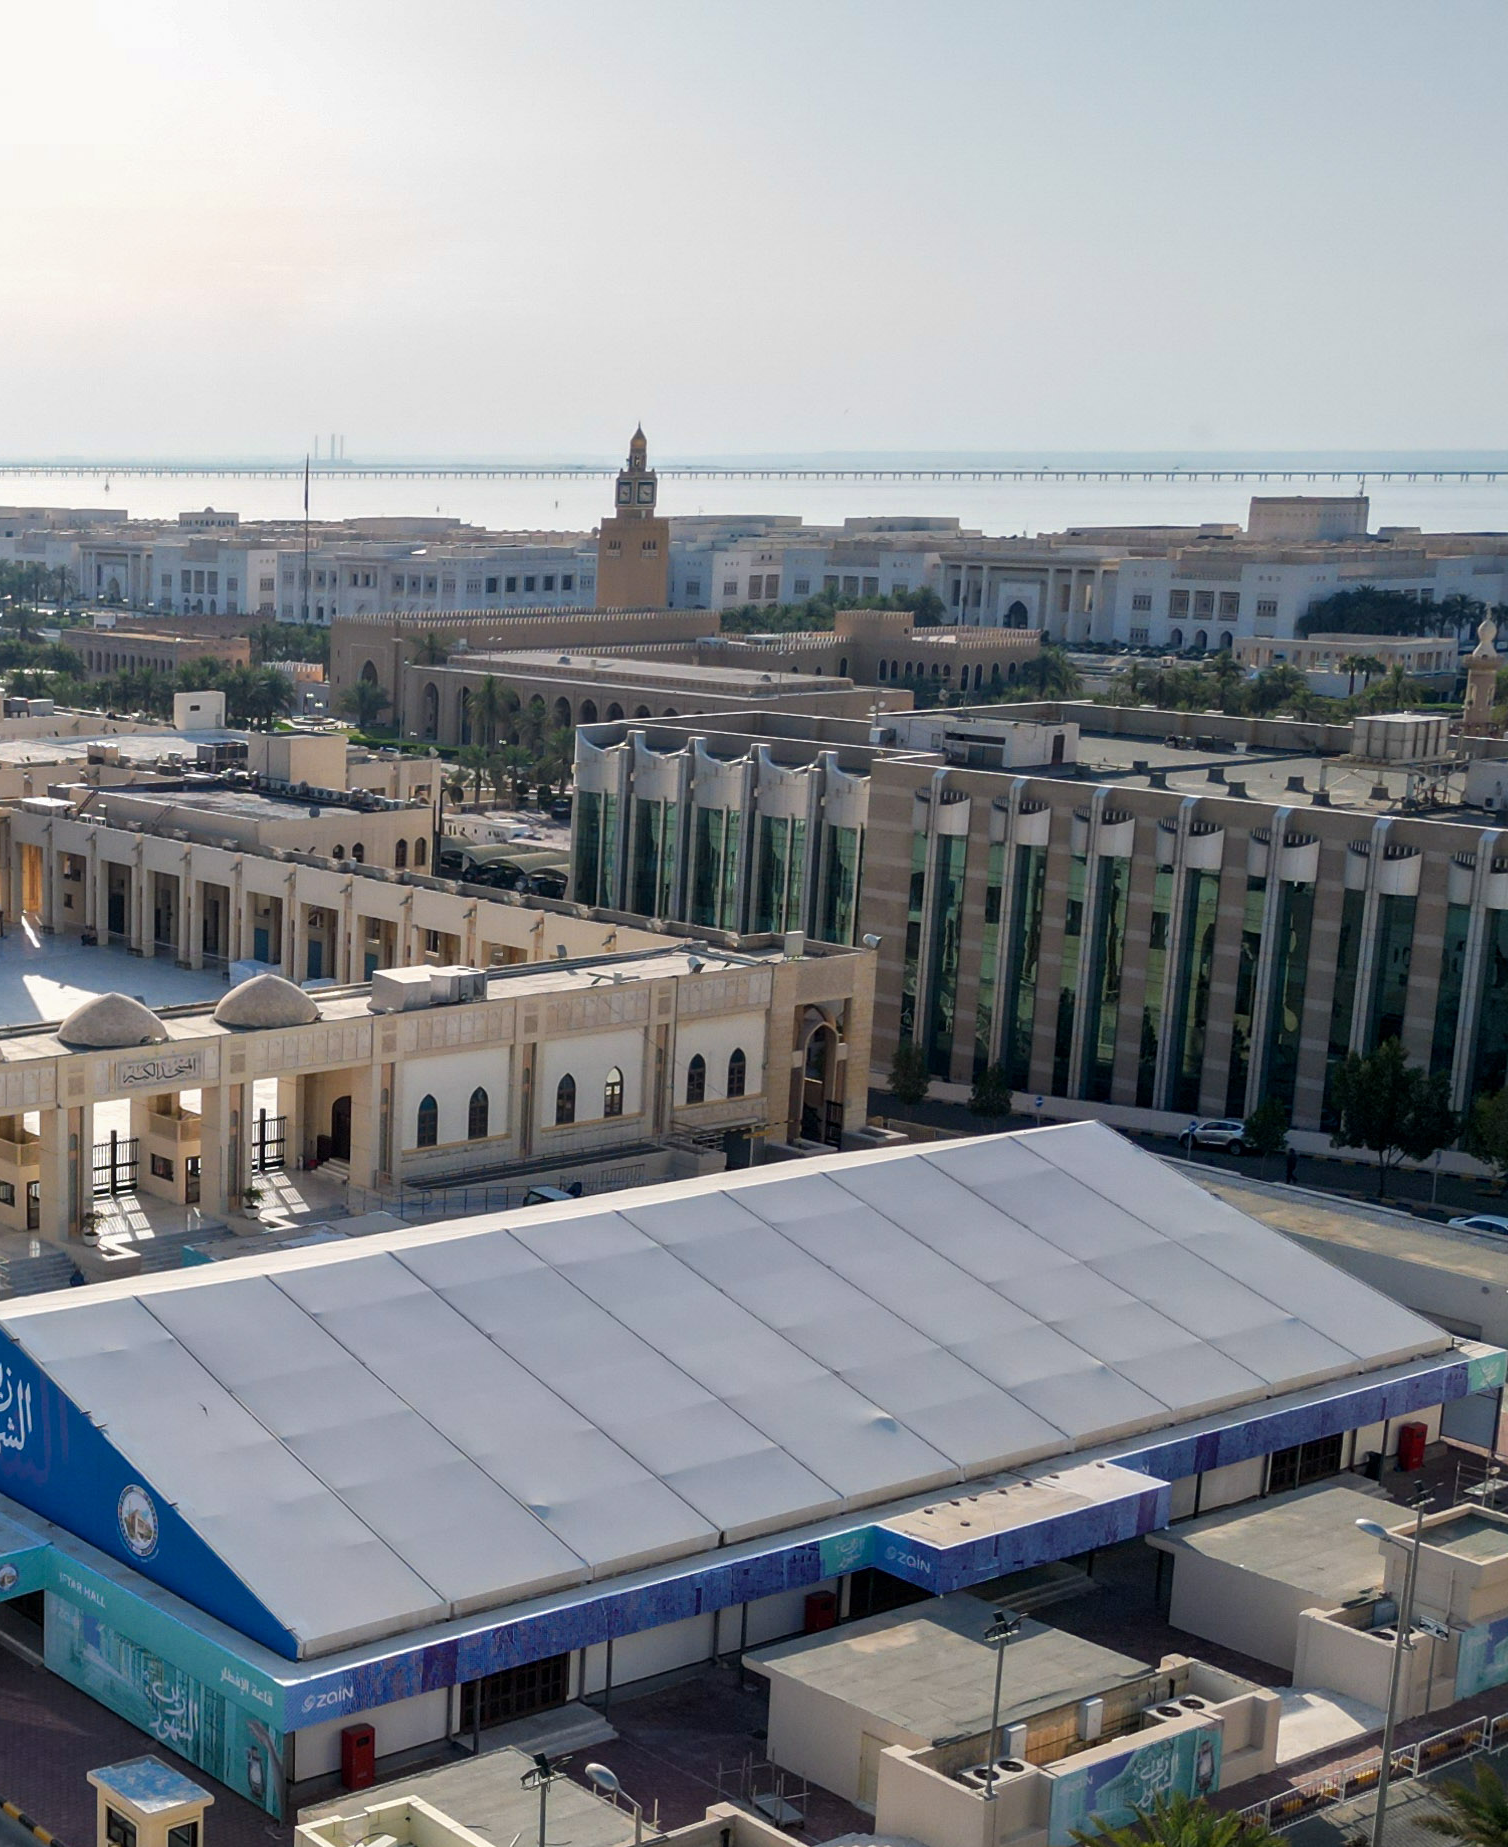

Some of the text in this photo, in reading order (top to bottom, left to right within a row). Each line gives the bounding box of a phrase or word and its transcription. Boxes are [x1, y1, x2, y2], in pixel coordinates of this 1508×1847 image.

[122, 1057, 197, 1084] المسجد الكبير
[83, 1585, 106, 1609] HALL
